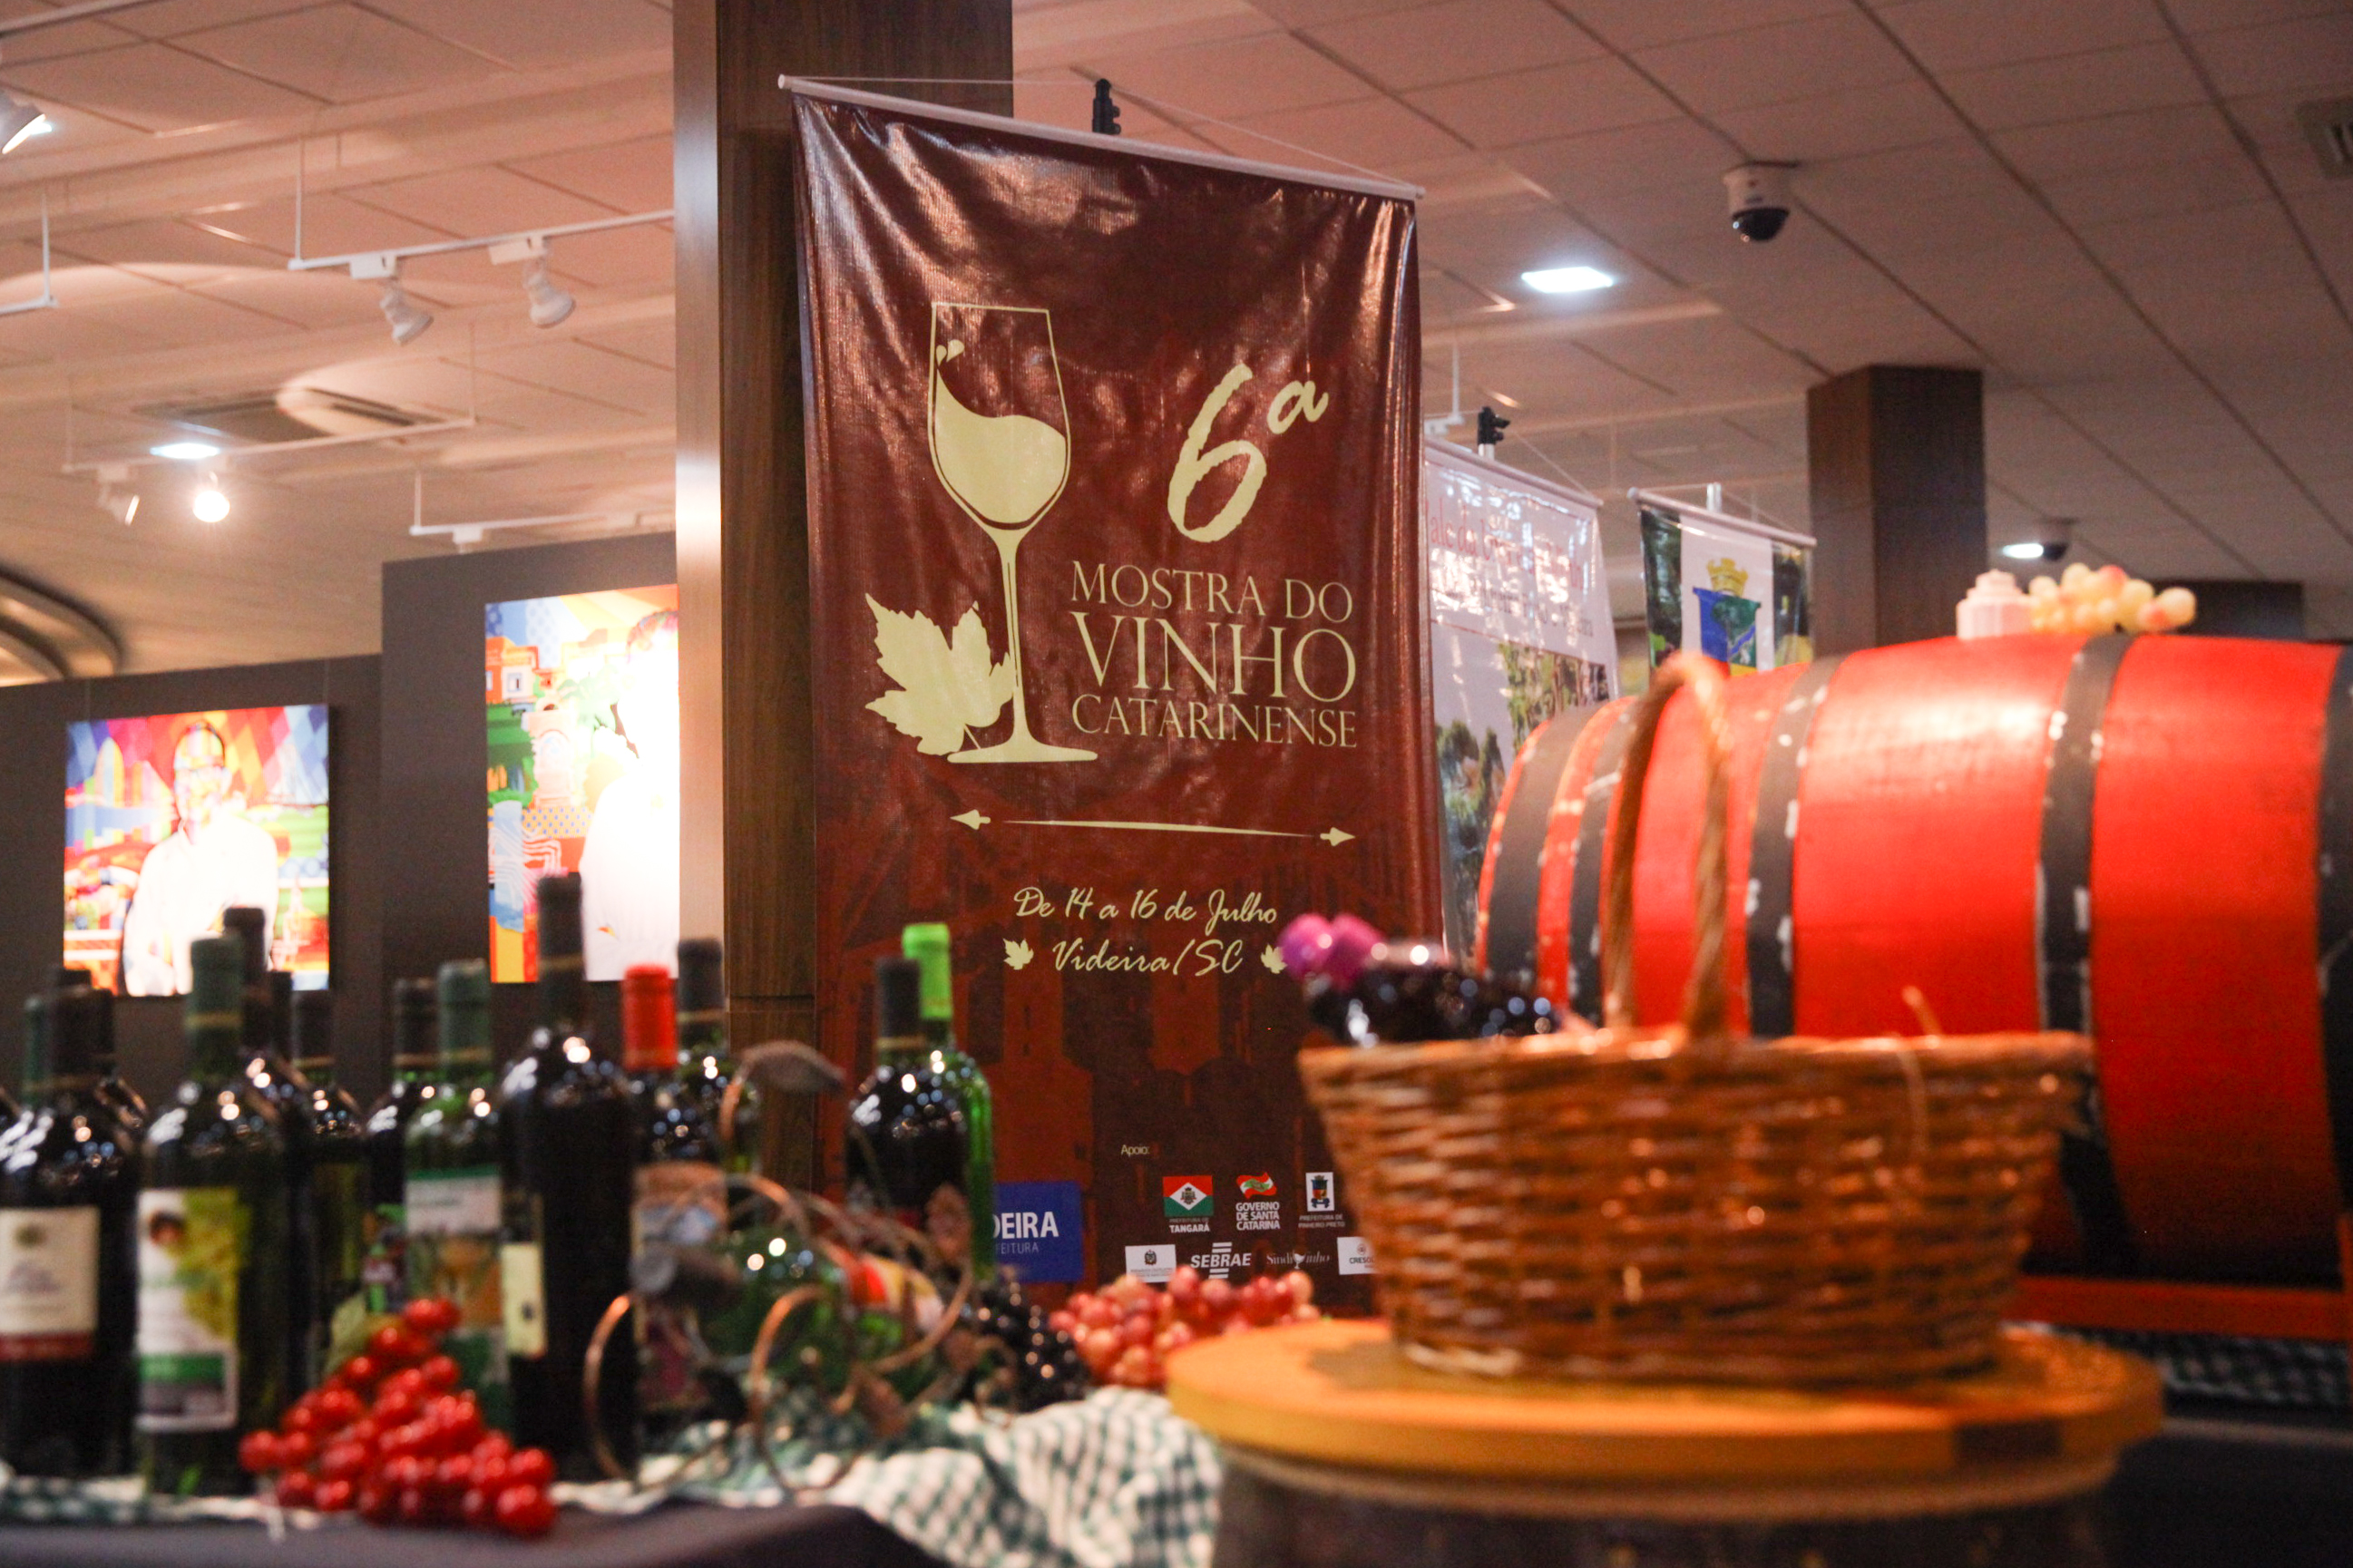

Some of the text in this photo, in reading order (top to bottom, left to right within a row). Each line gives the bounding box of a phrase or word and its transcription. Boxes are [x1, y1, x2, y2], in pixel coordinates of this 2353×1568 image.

[1071, 560, 1352, 623] MOSTRA DO
[1069, 611, 1356, 702] VINHO
[1072, 694, 1357, 748] CATARINENSE
[1013, 886, 1277, 936] De 14 a 16 de Julho
[1052, 937, 1243, 977] Videira/SC
[1235, 1202, 1280, 1212] GOVERNO
[1236, 1211, 1280, 1221] DE SANTA
[1169, 1222, 1210, 1233] TANGARÁ
[1236, 1220, 1281, 1231] CATARINA
[1190, 1252, 1252, 1268] SEBRAE
